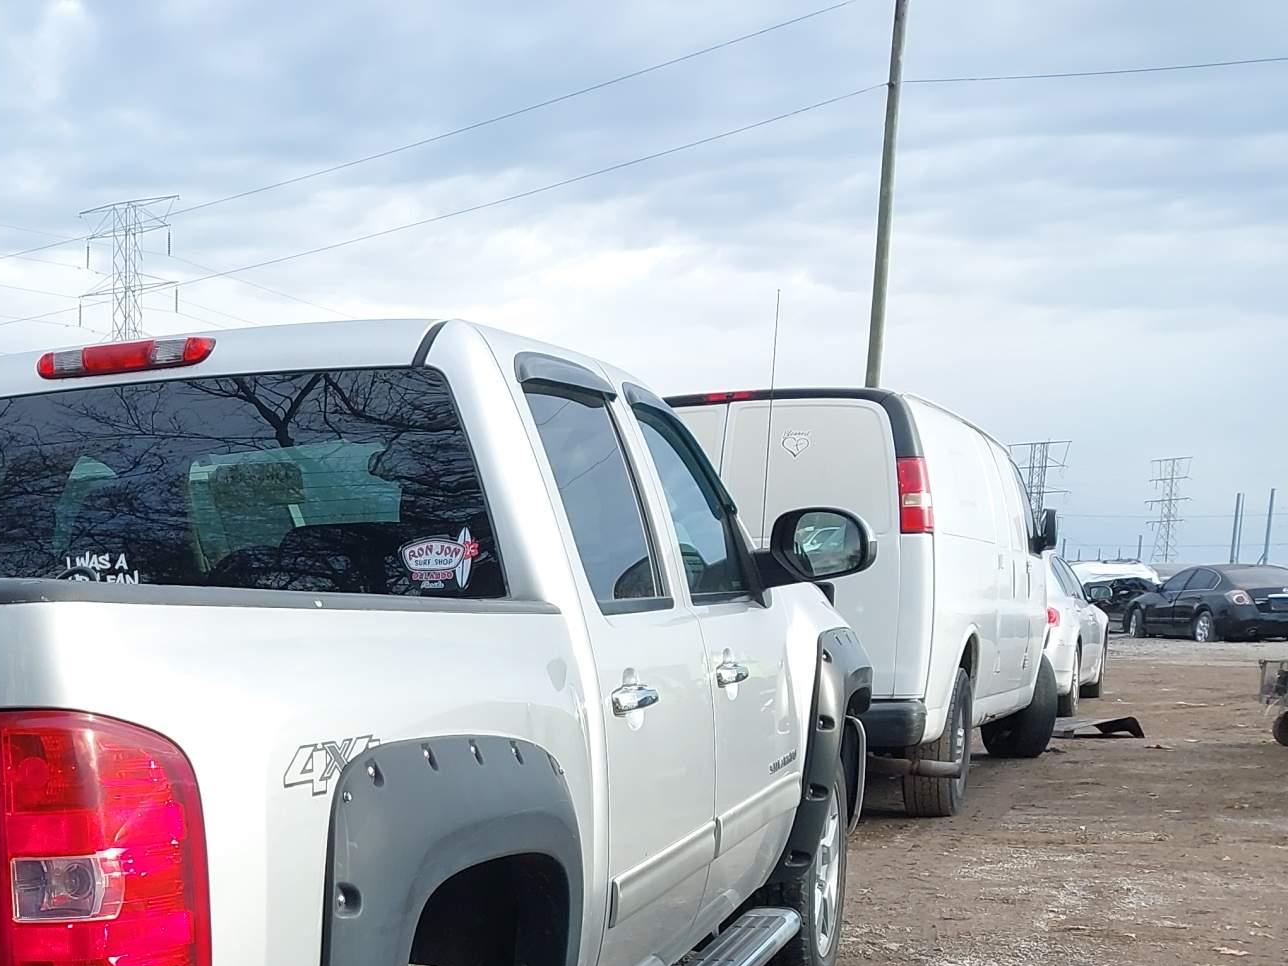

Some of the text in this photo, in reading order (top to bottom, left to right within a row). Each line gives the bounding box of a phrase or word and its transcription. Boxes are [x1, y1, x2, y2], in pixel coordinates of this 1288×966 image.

[408, 544, 461, 561] RON JON
[66, 551, 129, 571] I WAS A
[414, 558, 454, 567] SURF SHOP
[412, 571, 454, 581] ORLANDO
